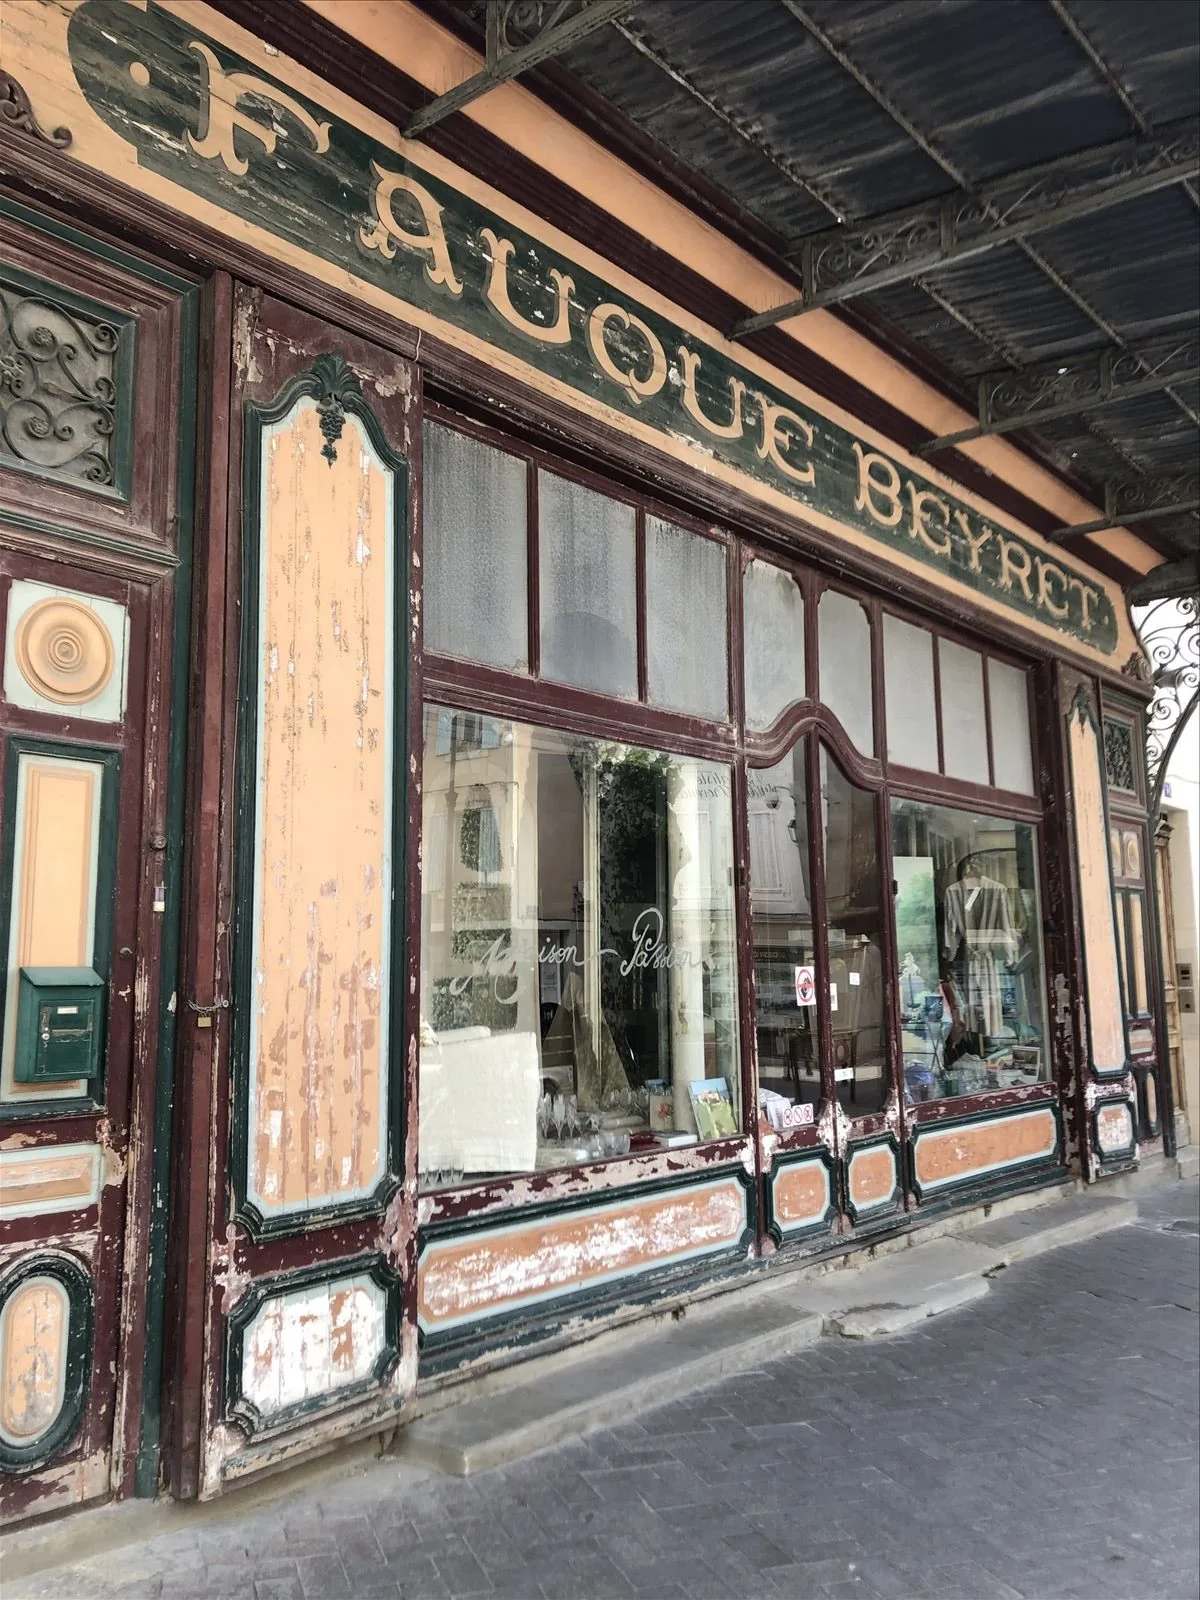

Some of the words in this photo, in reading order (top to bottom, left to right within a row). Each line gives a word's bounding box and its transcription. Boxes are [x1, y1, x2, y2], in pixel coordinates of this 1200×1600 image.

[182, 41, 816, 487] FAUQUE
[853, 441, 1101, 630] BEYRET
[449, 932, 597, 1005] Mison
